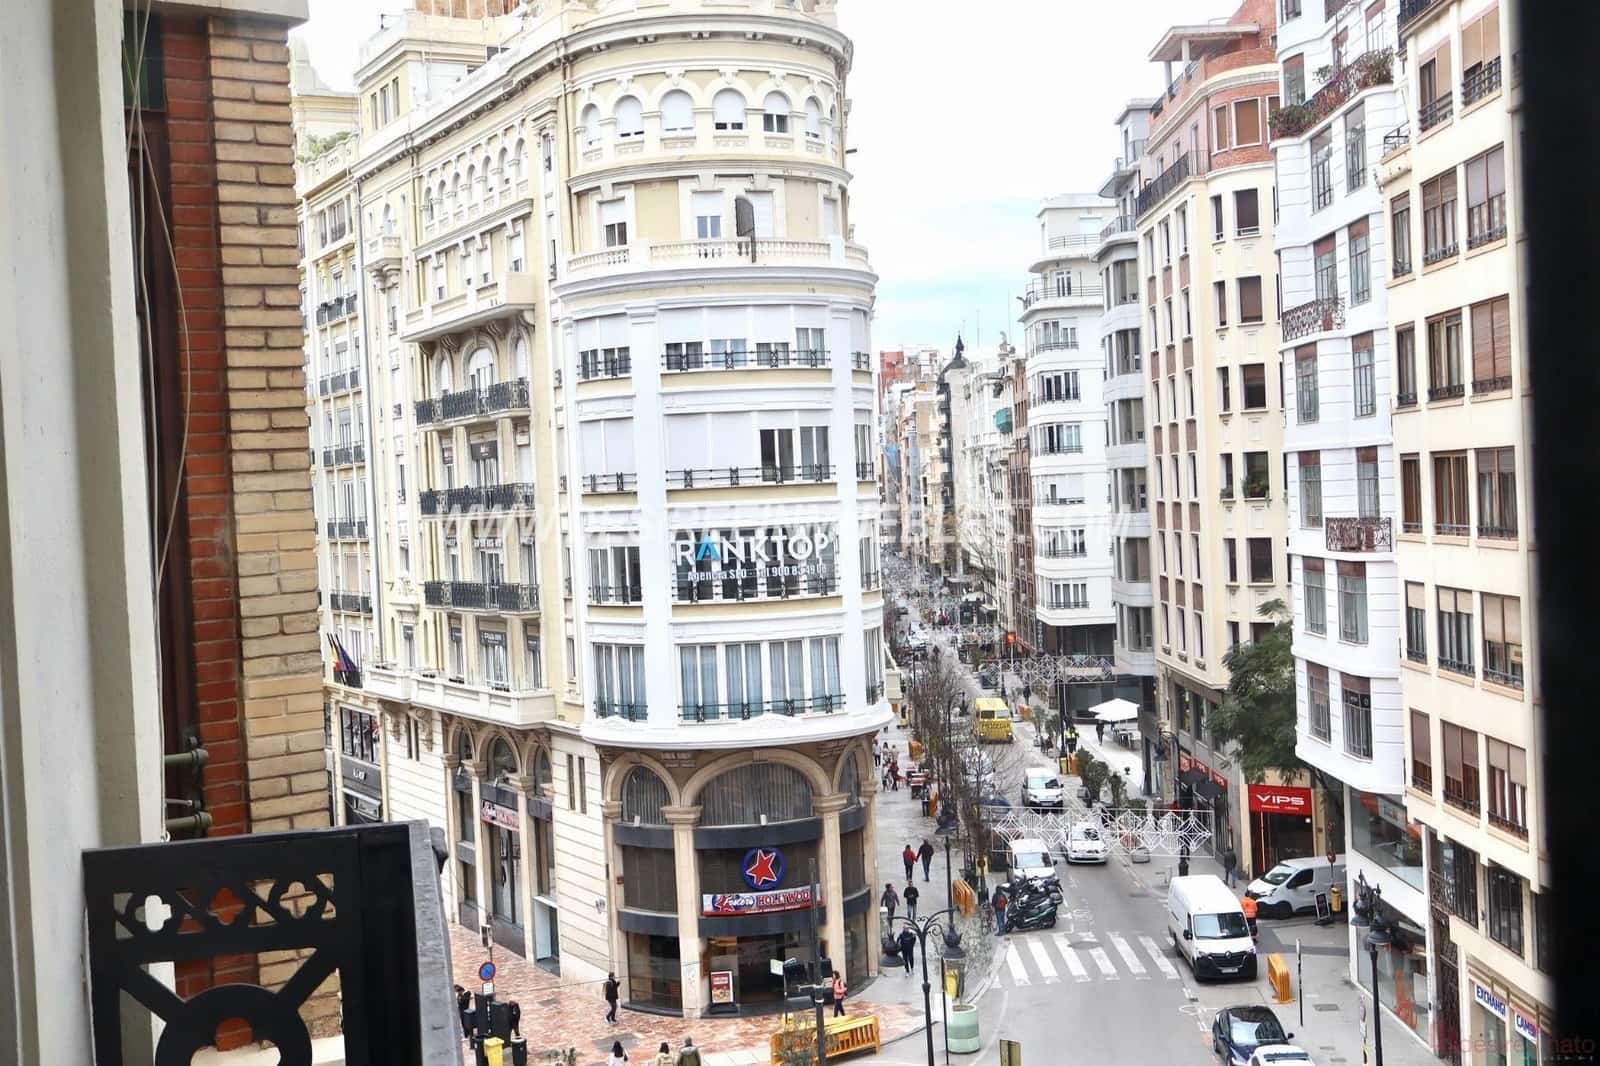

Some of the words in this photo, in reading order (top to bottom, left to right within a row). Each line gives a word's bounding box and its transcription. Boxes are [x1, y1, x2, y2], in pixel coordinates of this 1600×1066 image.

[677, 532, 829, 566] RANKTOP
[772, 565, 790, 577] 900
[1256, 794, 1304, 806] VIPS
[757, 889, 813, 905] HOLLYWOO
